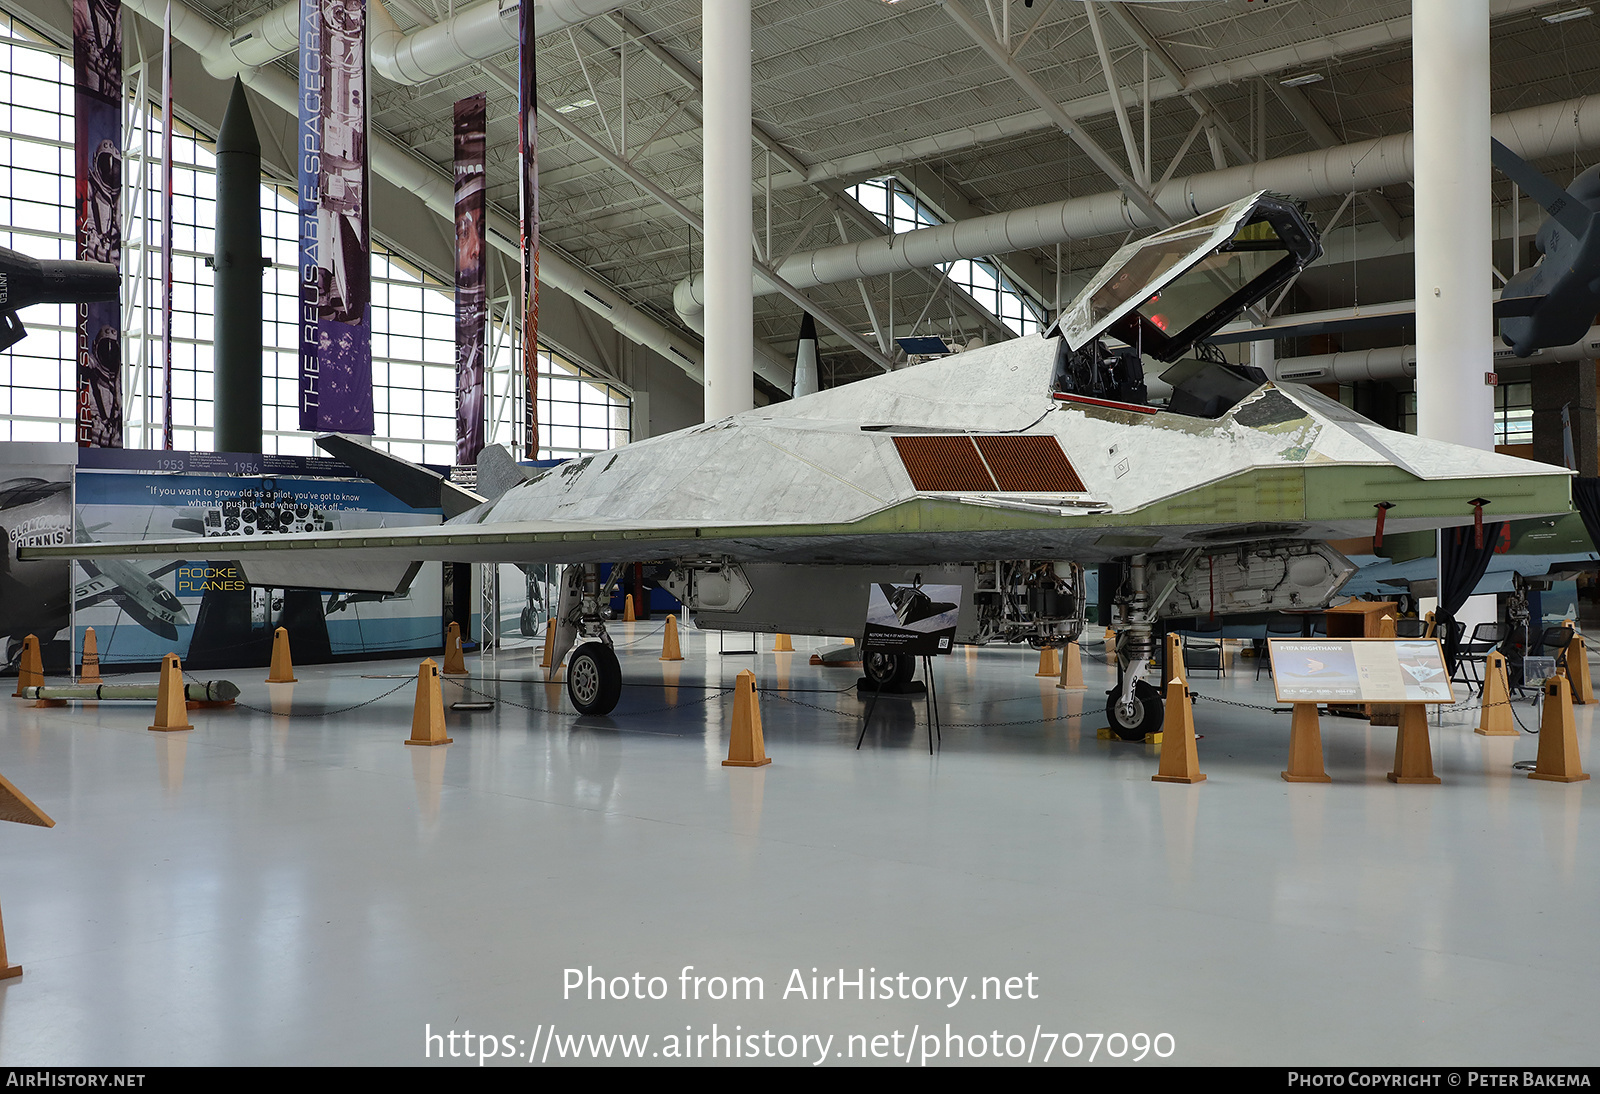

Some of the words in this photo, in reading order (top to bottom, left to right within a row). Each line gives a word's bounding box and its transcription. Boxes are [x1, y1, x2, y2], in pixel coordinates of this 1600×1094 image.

[80, 217, 90, 261] ALK
[304, 185, 320, 345] REUSABLE
[79, 302, 89, 366] SPAC
[304, 356, 319, 412] THE
[80, 375, 92, 442] FIRST
[157, 459, 184, 470] 1953
[233, 462, 259, 472] 1956
[159, 488, 176, 497] you
[178, 487, 201, 496] want
[203, 488, 212, 496] to
[214, 489, 237, 498] grow
[238, 489, 252, 497] old
[254, 490, 264, 498] as
[273, 490, 293, 500] pilot,
[294, 491, 318, 501] you've
[320, 493, 331, 502] got
[333, 493, 340, 501] to
[342, 493, 360, 501] know
[187, 499, 213, 508] when
[215, 500, 224, 508] to
[226, 500, 247, 509] push
[260, 501, 275, 509] and
[276, 502, 298, 510] when
[309, 502, 327, 511] back
[178, 567, 237, 578] ROCKE
[178, 580, 245, 591] PLANES
